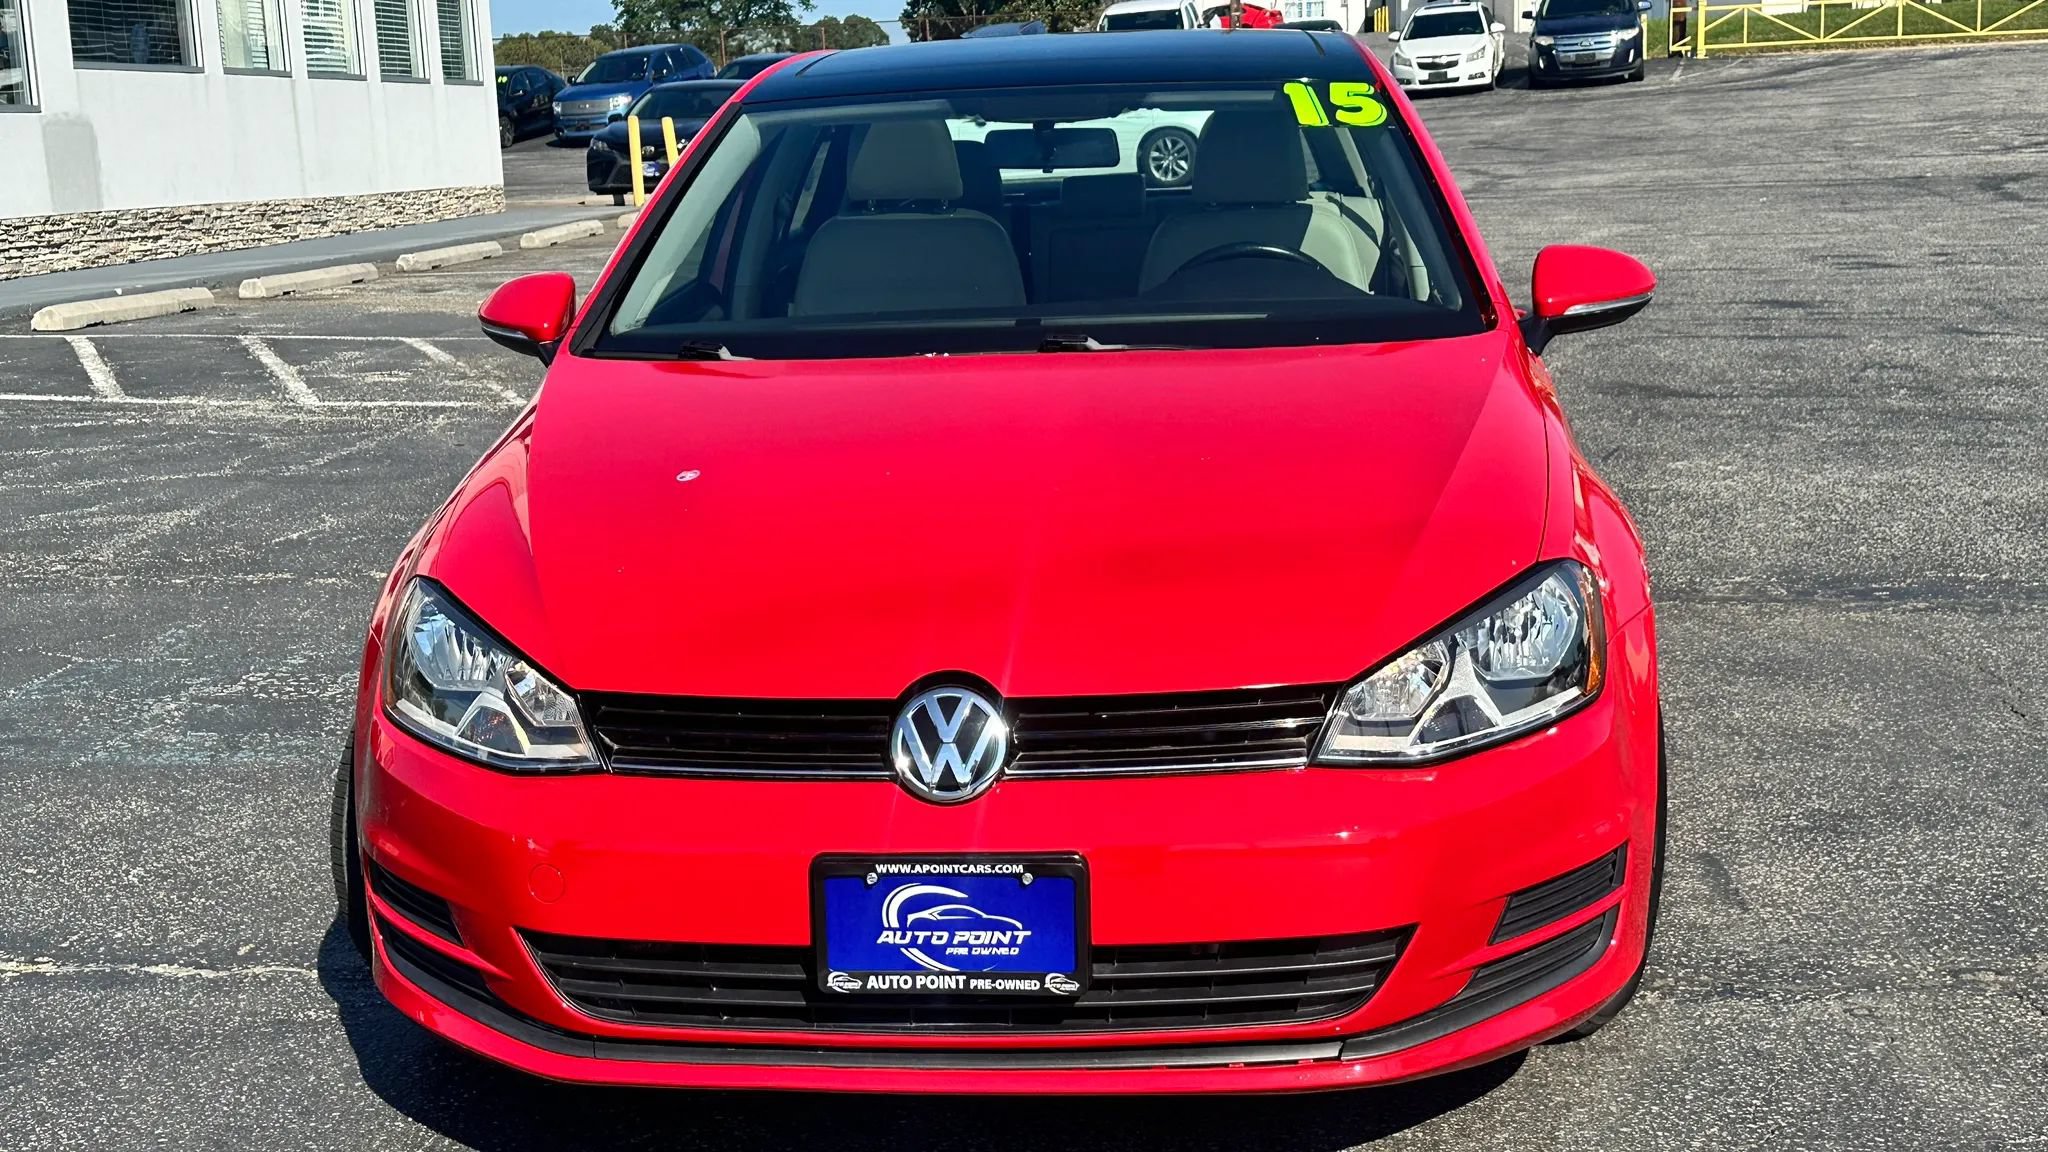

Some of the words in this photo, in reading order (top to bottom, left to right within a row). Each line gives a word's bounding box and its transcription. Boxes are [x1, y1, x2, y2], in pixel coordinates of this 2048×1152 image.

[1283, 82, 1387, 126] 15
[891, 687, 1008, 801] VW
[876, 863, 1024, 874] WWW.APOINTCARS.COM
[876, 930, 949, 945] AUTO
[952, 930, 1032, 945] POINT
[945, 947, 969, 956] PRE
[971, 947, 1020, 956] OWNED
[866, 975, 913, 990] AUTO
[915, 975, 966, 990] POINT
[969, 978, 1041, 991] PRE-OWNED
